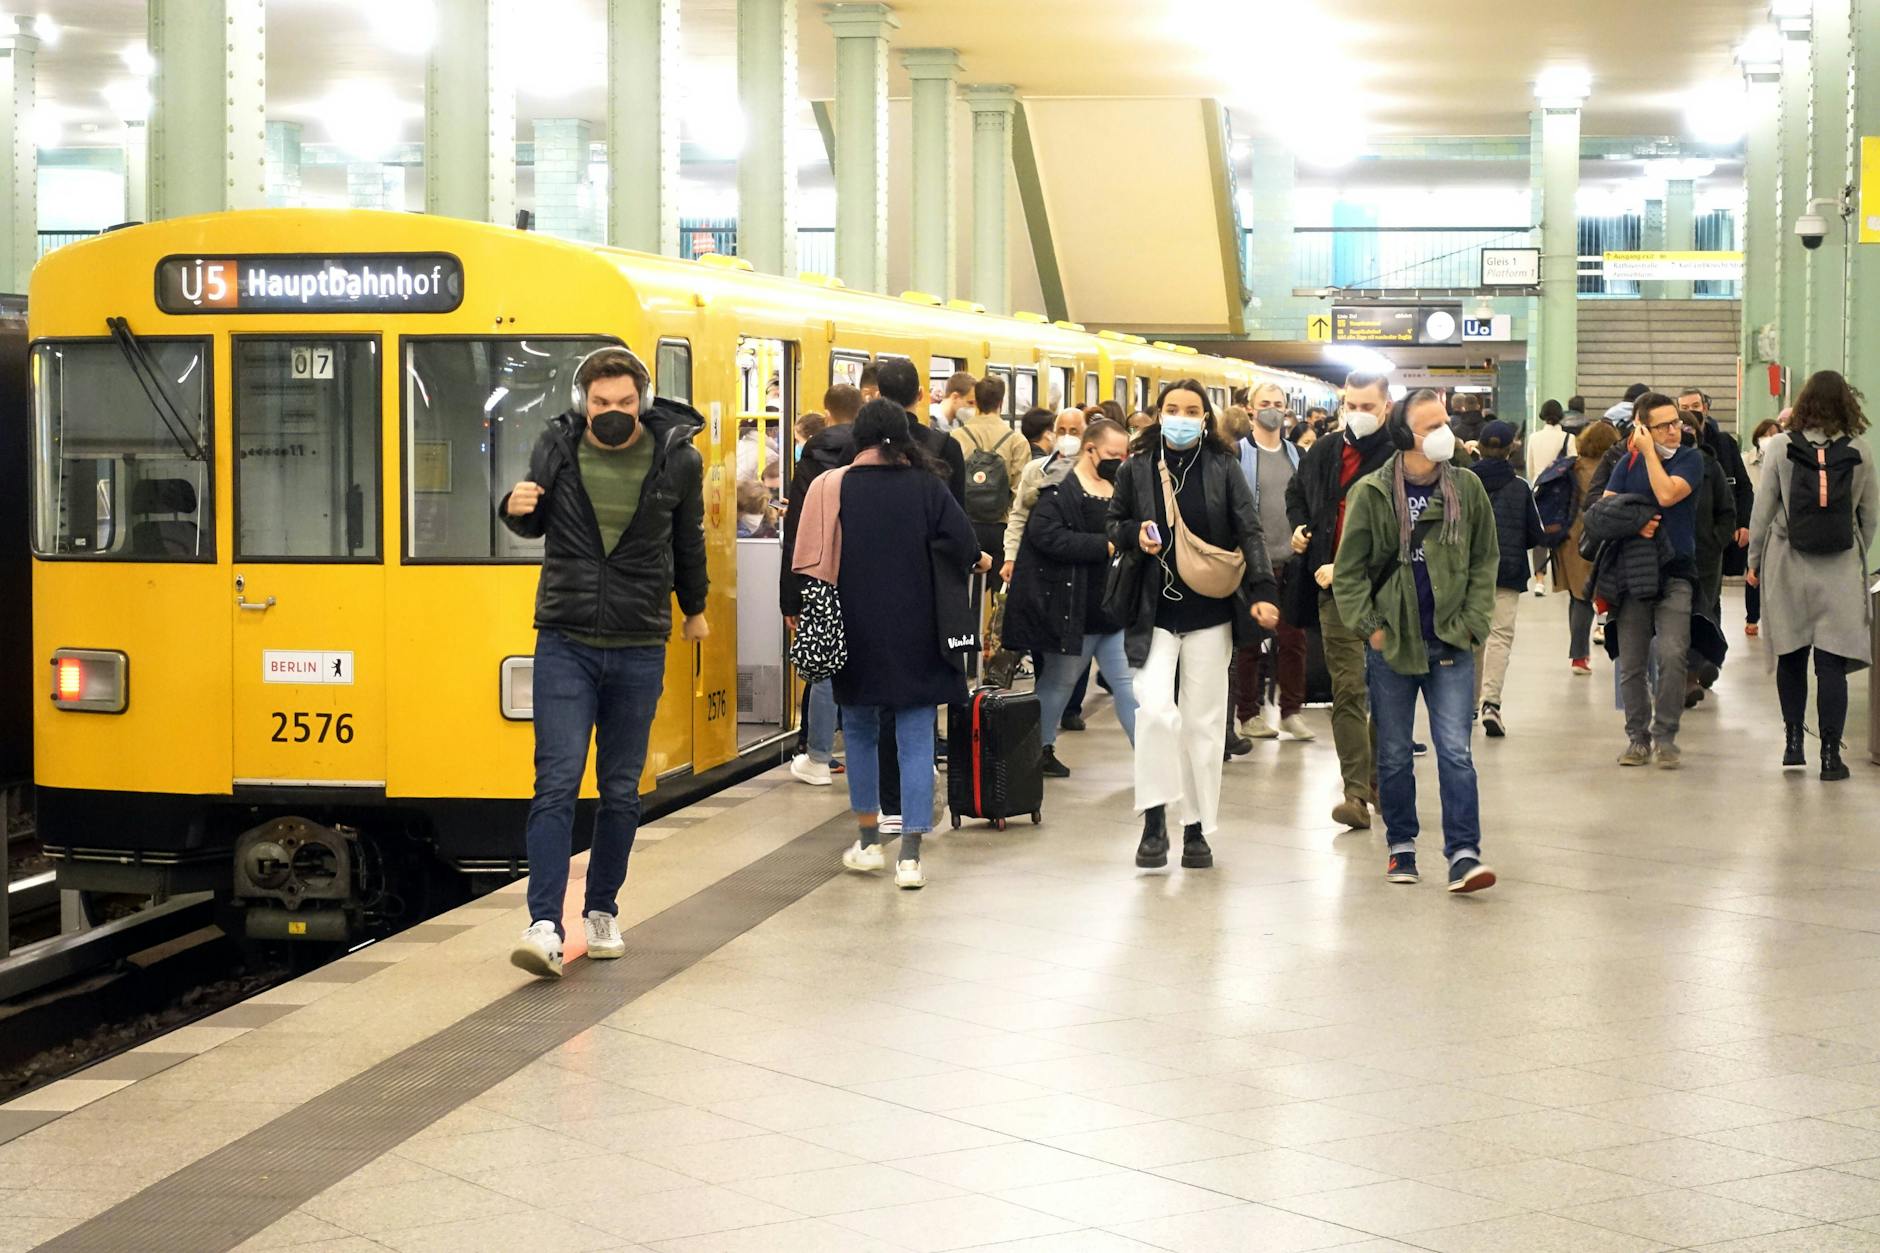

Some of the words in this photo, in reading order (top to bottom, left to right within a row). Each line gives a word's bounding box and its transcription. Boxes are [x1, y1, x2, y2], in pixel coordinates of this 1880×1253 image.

[1486, 256, 1510, 266] Gleis
[1512, 256, 1517, 266] 1
[1486, 268, 1528, 278] Platform
[181, 265, 227, 301] U5
[249, 265, 441, 303] Hauptbahnhof
[1407, 496, 1428, 510] DA
[271, 660, 317, 673] BERLIN
[708, 689, 727, 721] 2576
[271, 712, 354, 744] 2576
